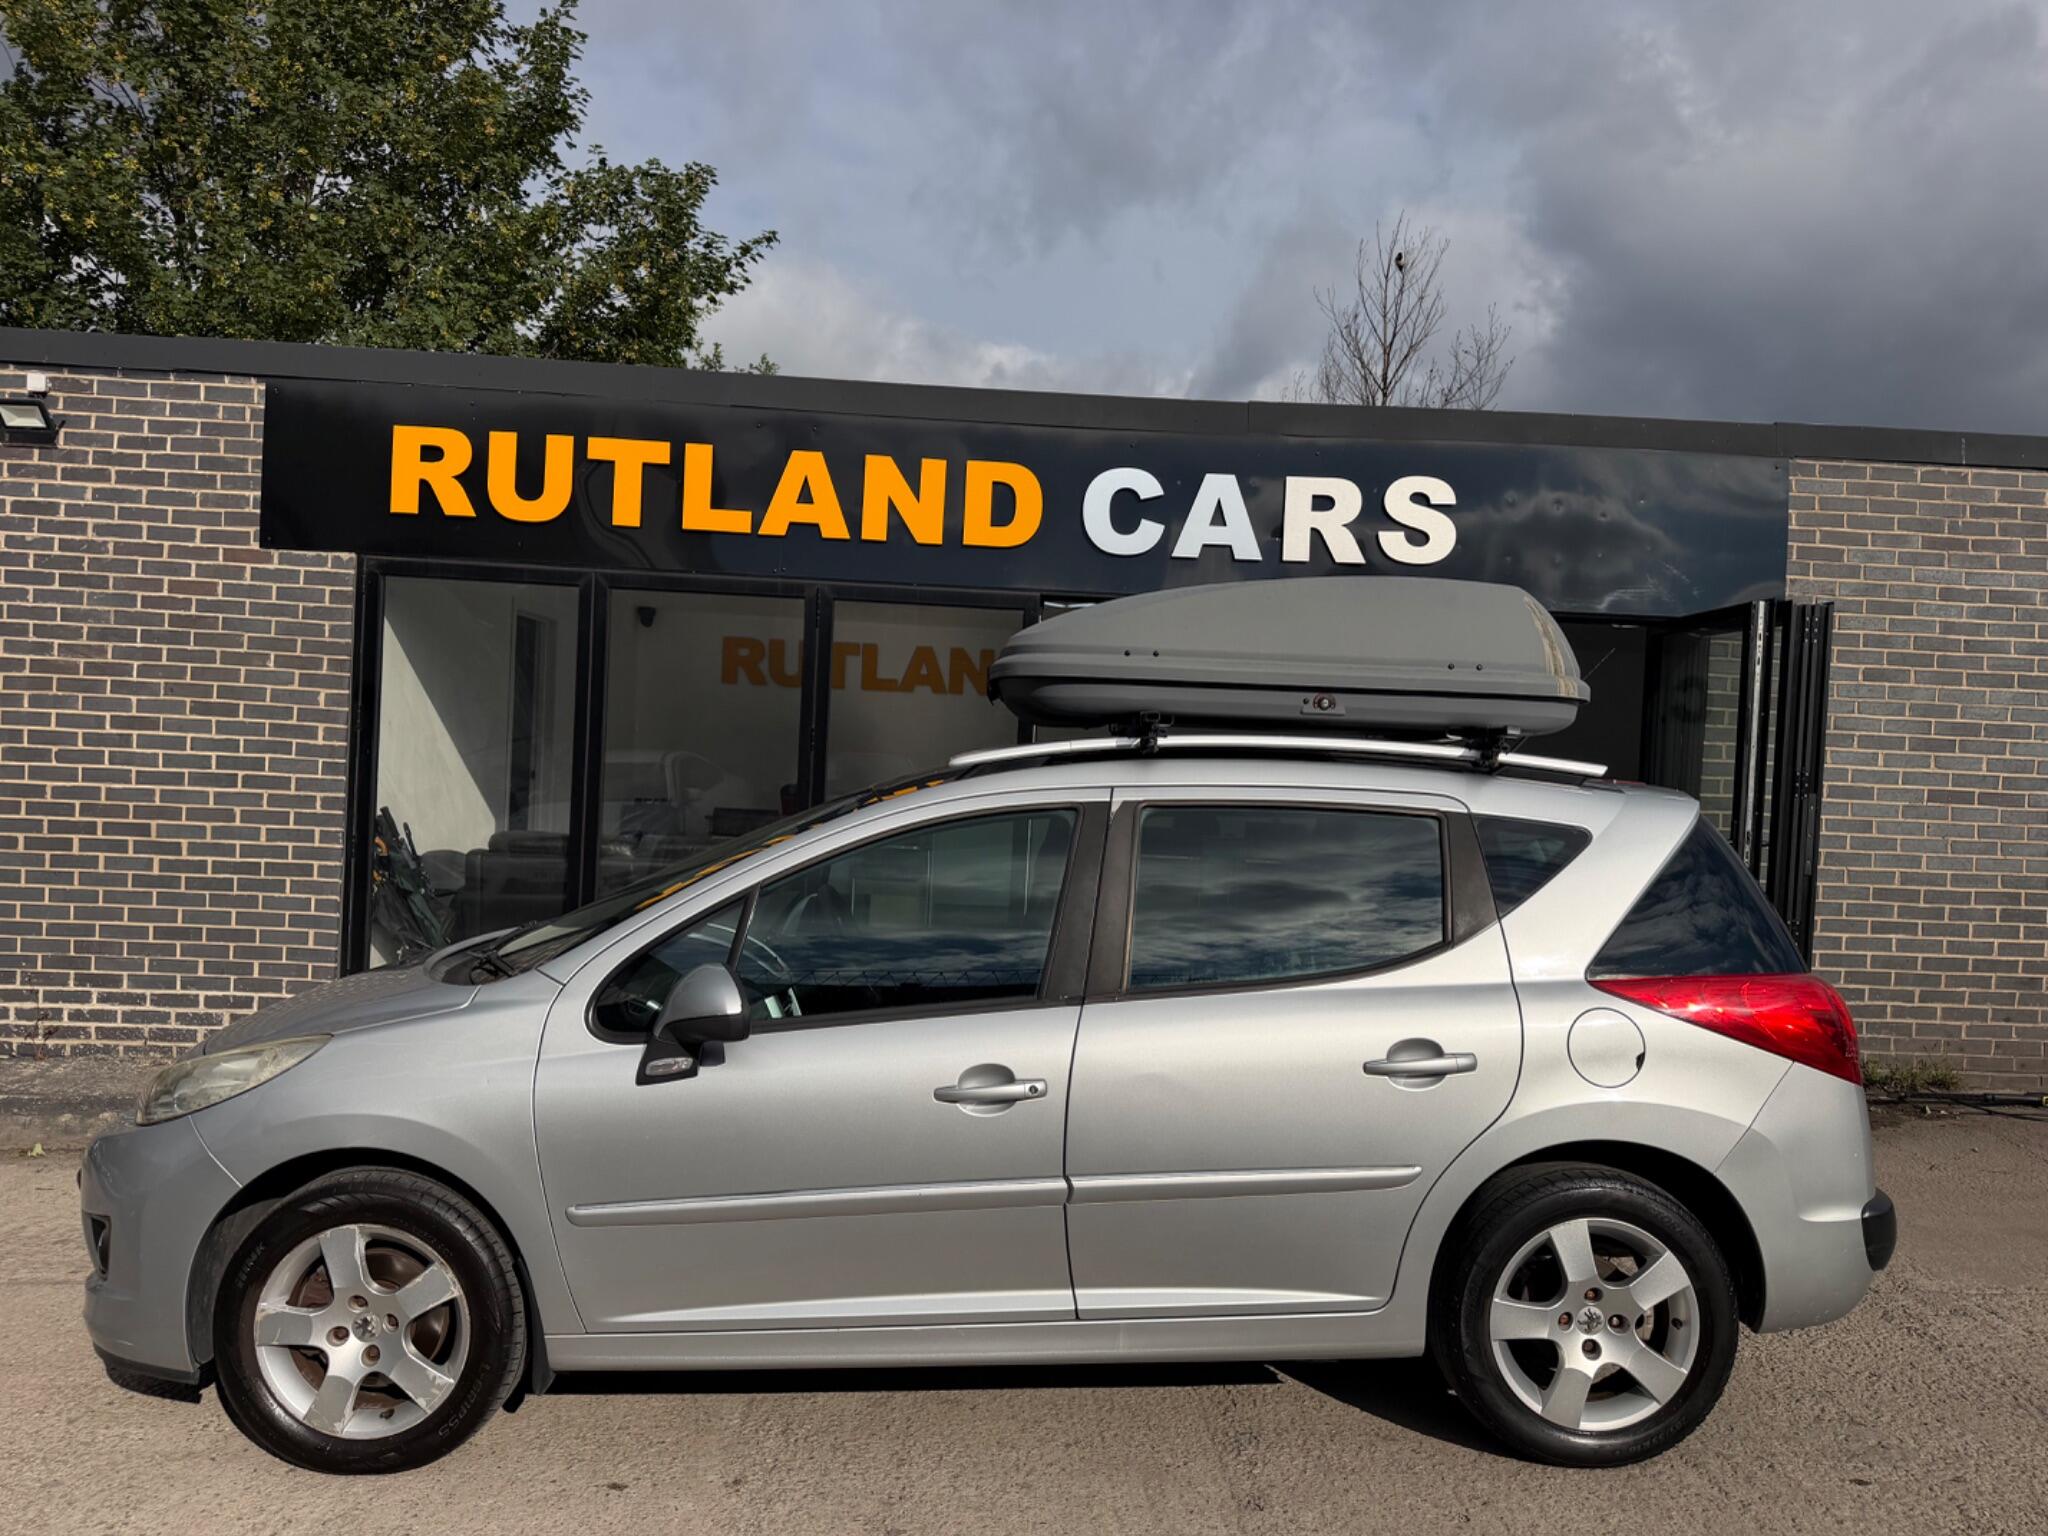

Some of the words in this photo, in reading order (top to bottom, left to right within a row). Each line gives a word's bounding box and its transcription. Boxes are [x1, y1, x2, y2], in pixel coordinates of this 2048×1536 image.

[391, 425, 1043, 547] RUTLAND
[1083, 468, 1457, 565] CARS
[721, 636, 995, 696] RUTLAN
